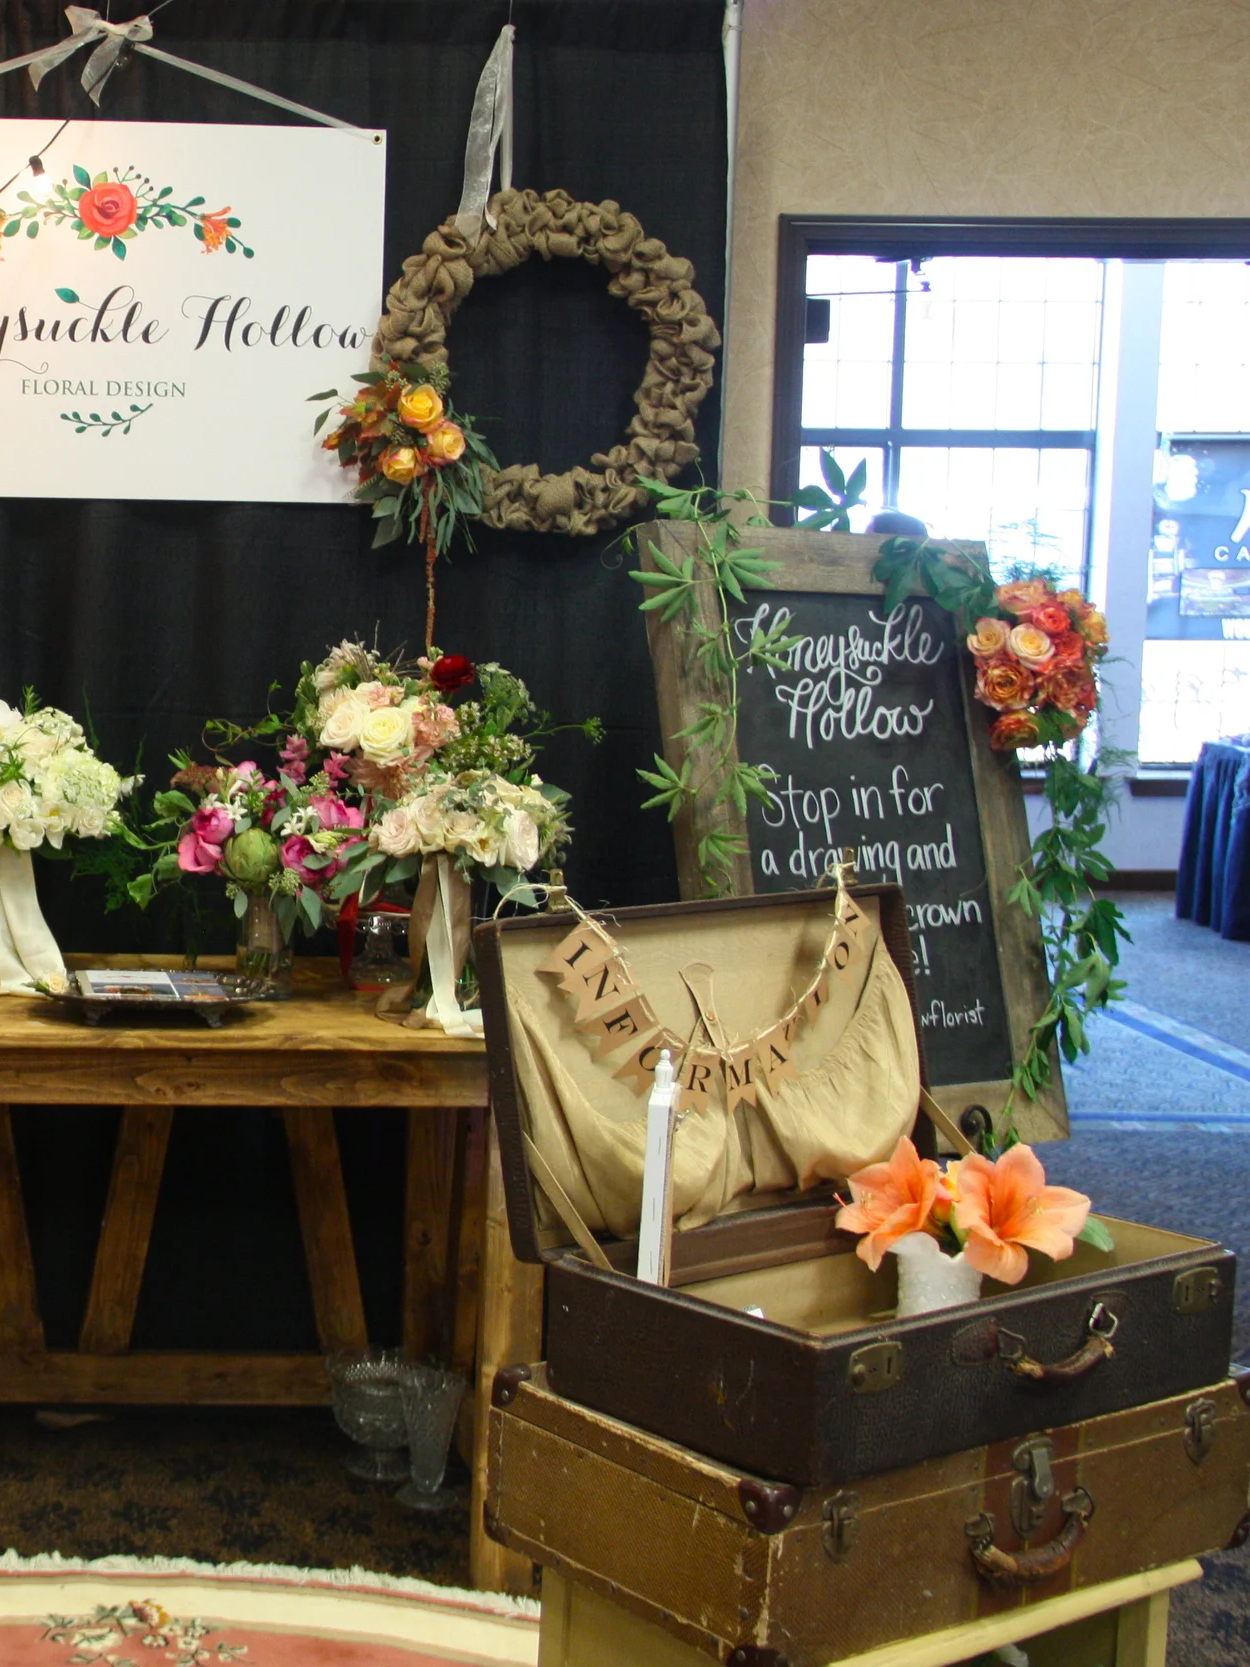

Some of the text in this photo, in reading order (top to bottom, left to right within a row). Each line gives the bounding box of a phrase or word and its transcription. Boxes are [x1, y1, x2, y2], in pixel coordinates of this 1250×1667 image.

[181, 295, 374, 352] Hollow
[21, 378, 187, 398] FLORAL DESIGN
[775, 677, 934, 749] Hollow
[757, 763, 944, 845] Stop in for
[761, 848, 780, 876] a
[906, 822, 957, 870] and
